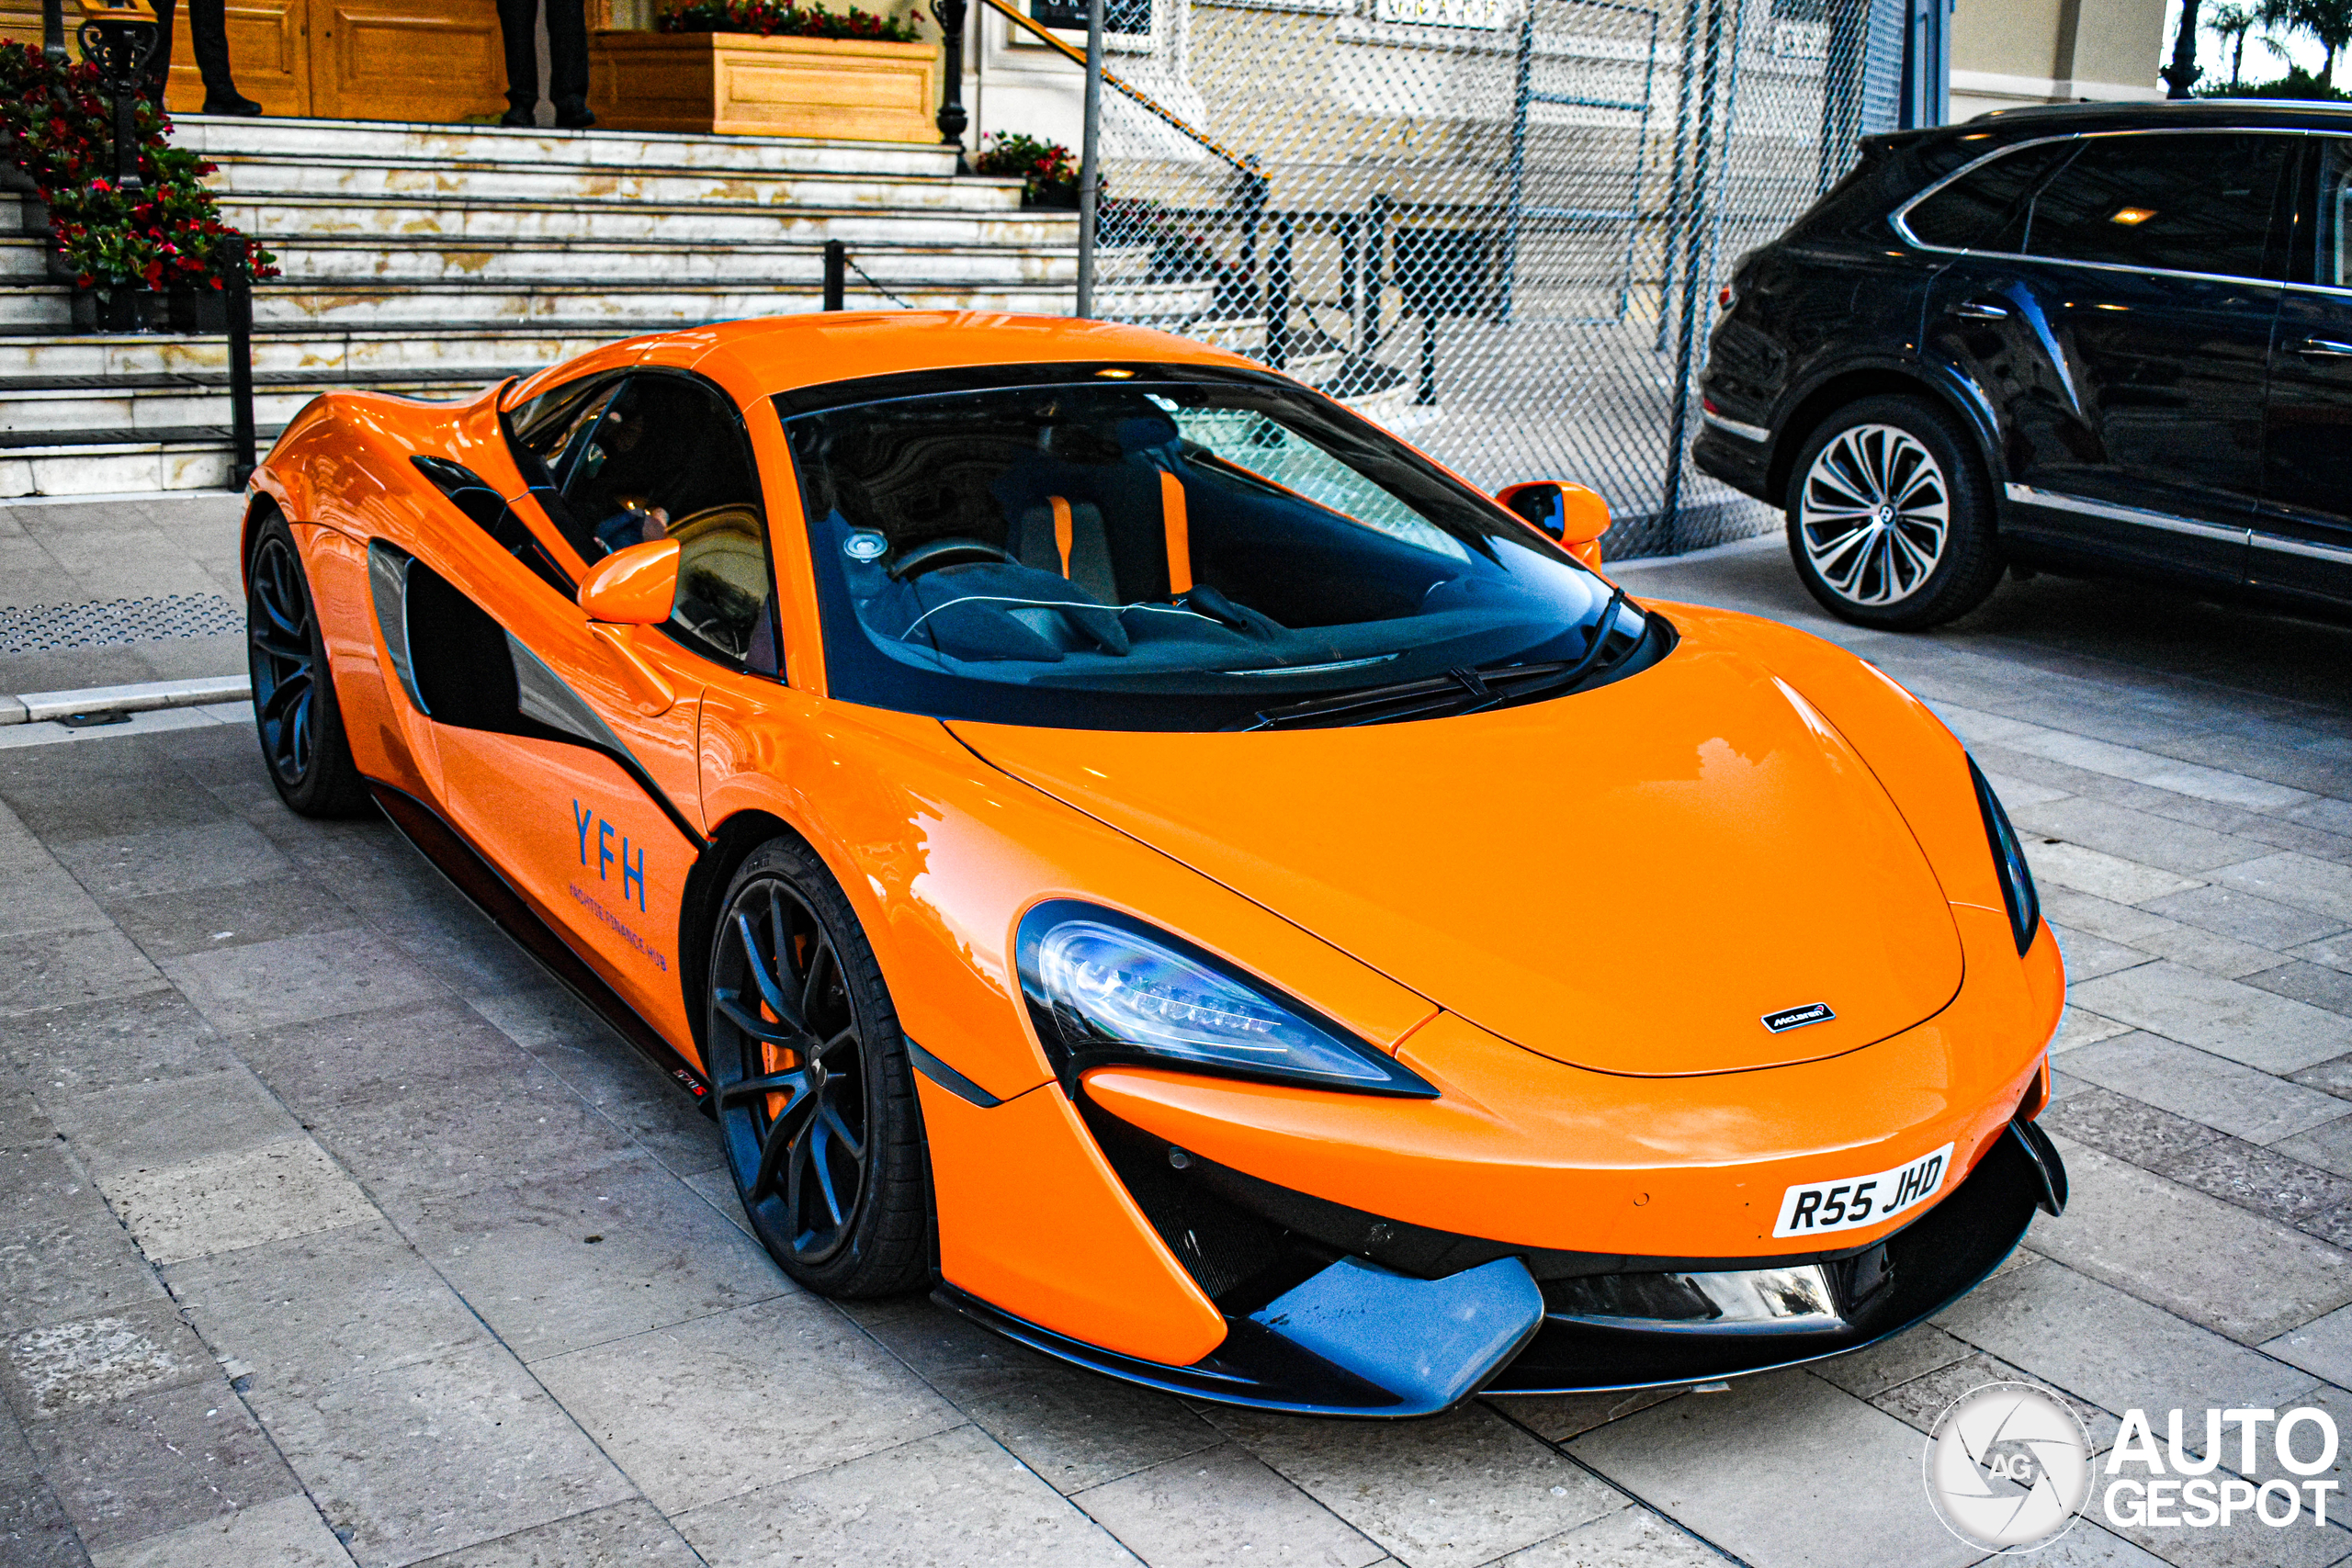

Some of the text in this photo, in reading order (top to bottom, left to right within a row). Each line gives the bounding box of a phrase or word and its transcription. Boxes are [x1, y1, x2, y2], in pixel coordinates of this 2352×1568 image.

[573, 798, 646, 913] YFH
[647, 944, 667, 972] HUB
[1774, 1009, 1824, 1027] McLaren
[1790, 1155, 1942, 1230] R55 JHD
